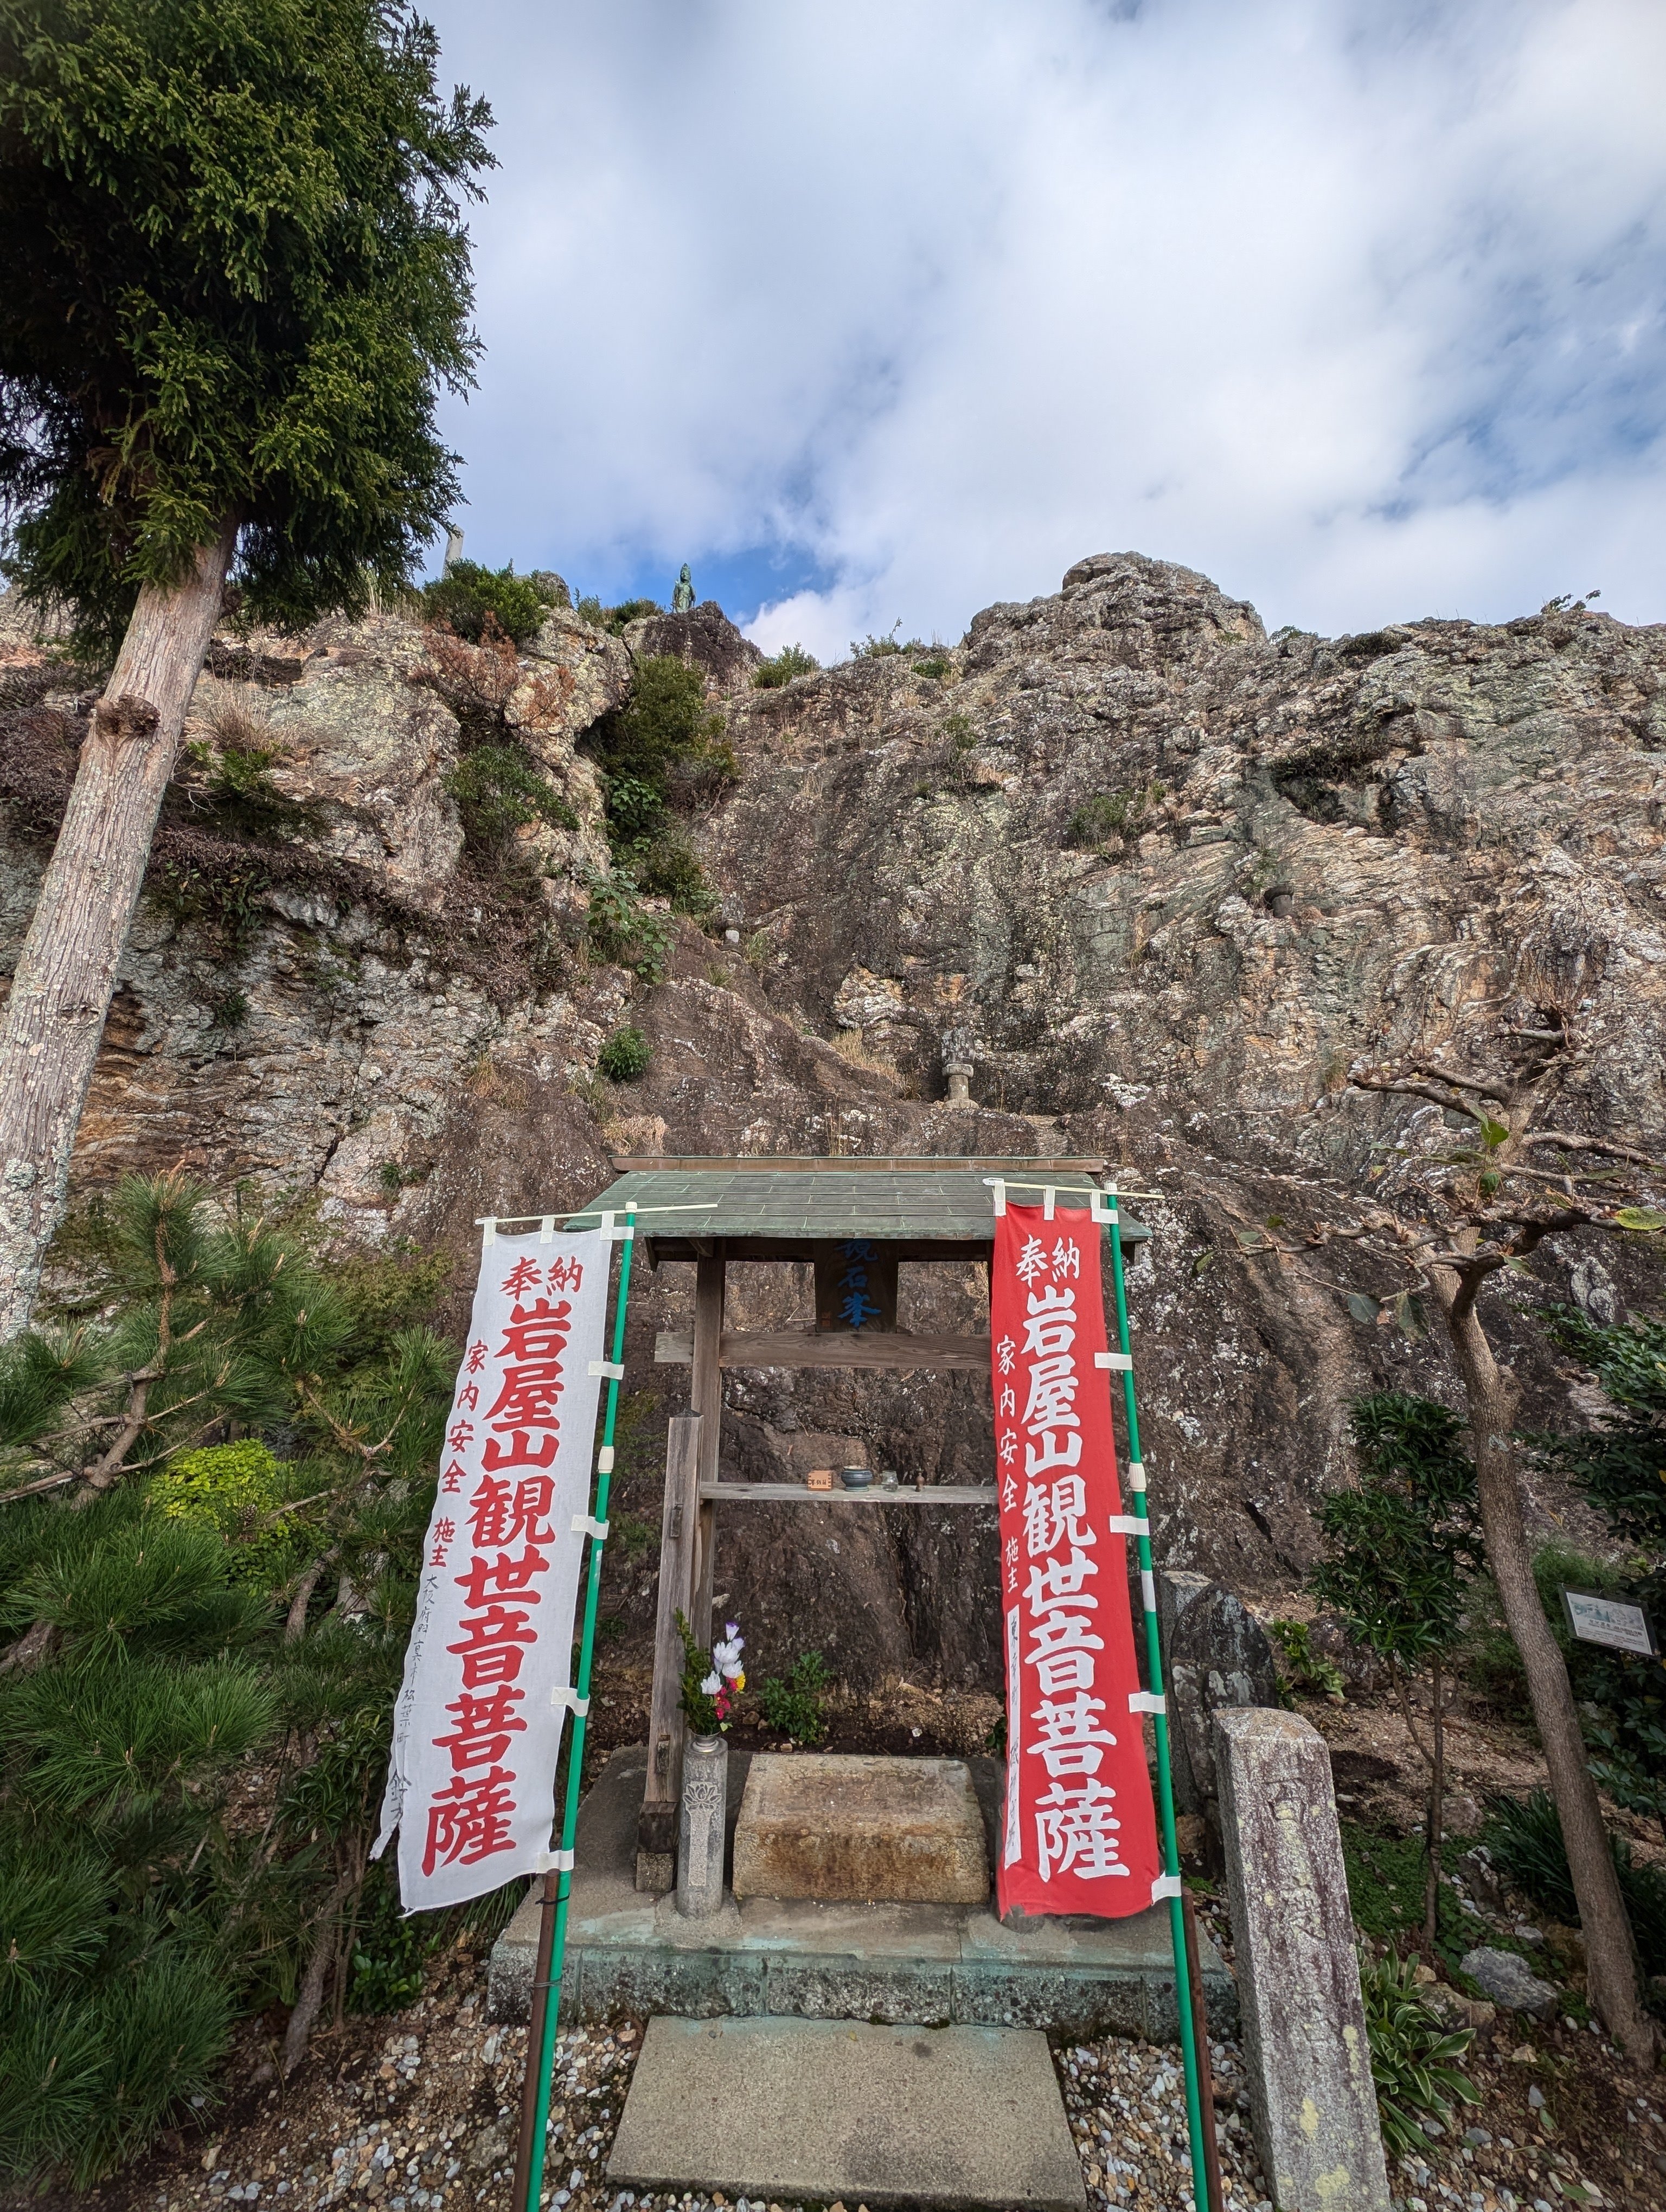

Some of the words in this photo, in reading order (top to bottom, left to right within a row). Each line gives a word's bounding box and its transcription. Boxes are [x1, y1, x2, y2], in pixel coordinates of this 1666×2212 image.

[501, 1256, 584, 1300] 奉納
[1015, 1234, 1080, 1288] 奉納
[441, 1339, 489, 1494] 家内安全
[996, 1334, 1018, 1513] 家内安全
[421, 1297, 572, 1877] 岩屋山観世音菩薩
[429, 1516, 456, 1567] 施主
[1005, 1536, 1019, 1593] 施主
[1020, 1284, 1130, 1883] 岩屋山観世音菩薩
